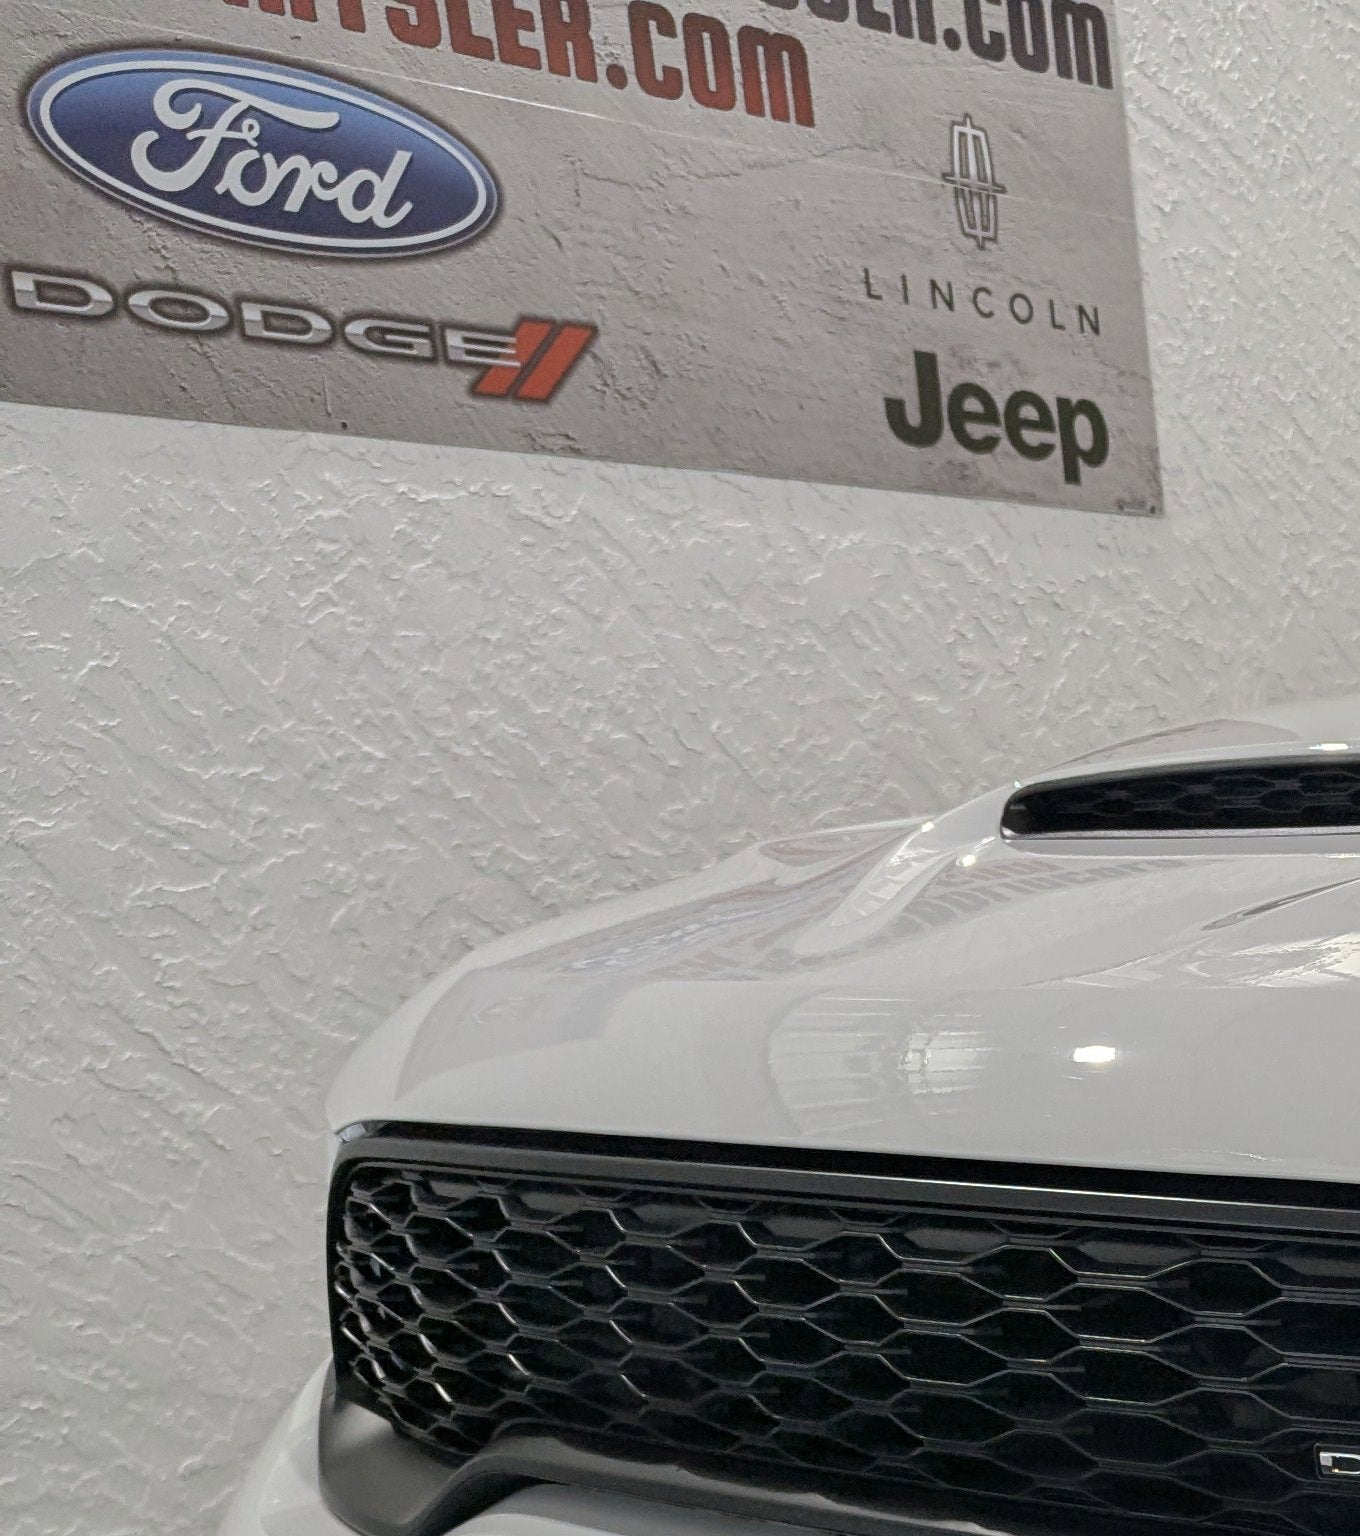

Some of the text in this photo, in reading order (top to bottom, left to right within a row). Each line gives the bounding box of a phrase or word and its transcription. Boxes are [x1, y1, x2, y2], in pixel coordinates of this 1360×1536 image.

[130, 79, 414, 229] Ford
[10, 270, 522, 369] DODGE
[864, 267, 1101, 336] LINCOLN
[883, 350, 1110, 486] Jeep
